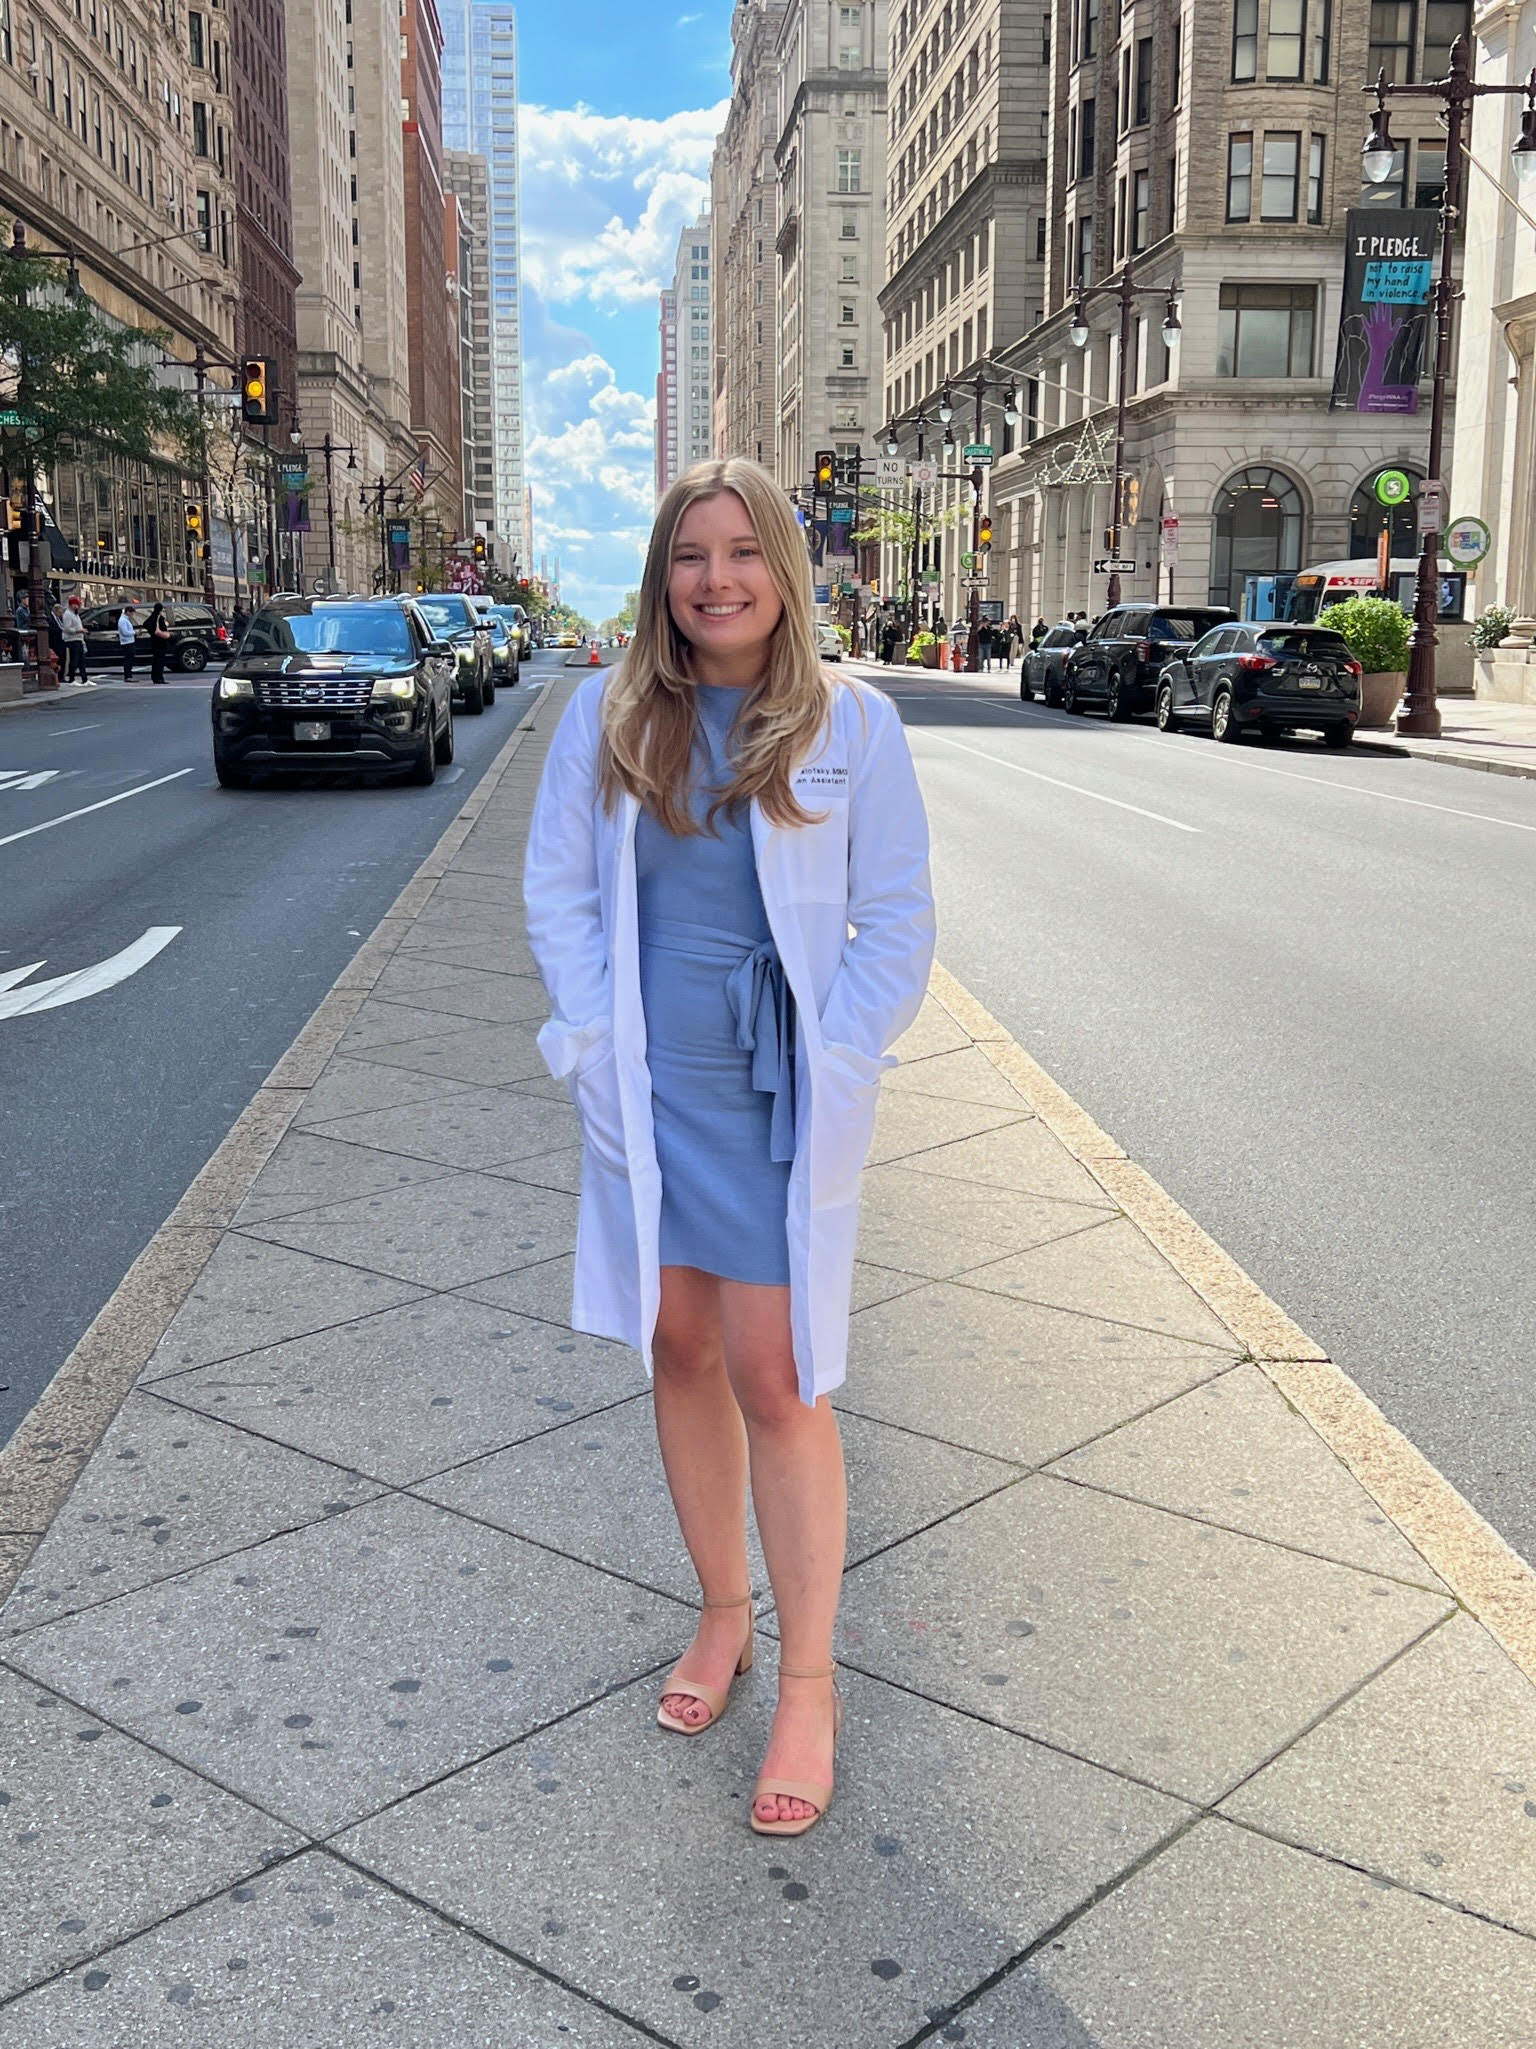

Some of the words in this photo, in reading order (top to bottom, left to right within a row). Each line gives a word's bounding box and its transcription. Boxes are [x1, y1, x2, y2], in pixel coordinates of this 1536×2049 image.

[1355, 237, 1367, 256] I
[1369, 264, 1382, 274] not
[1389, 262, 1398, 274] to
[1401, 264, 1423, 274] raise
[1367, 278, 1381, 289] my
[1384, 275, 1410, 286] hand
[1366, 290, 1375, 298] in
[883, 462, 898, 472] NO
[877, 476, 904, 485] TURNS
